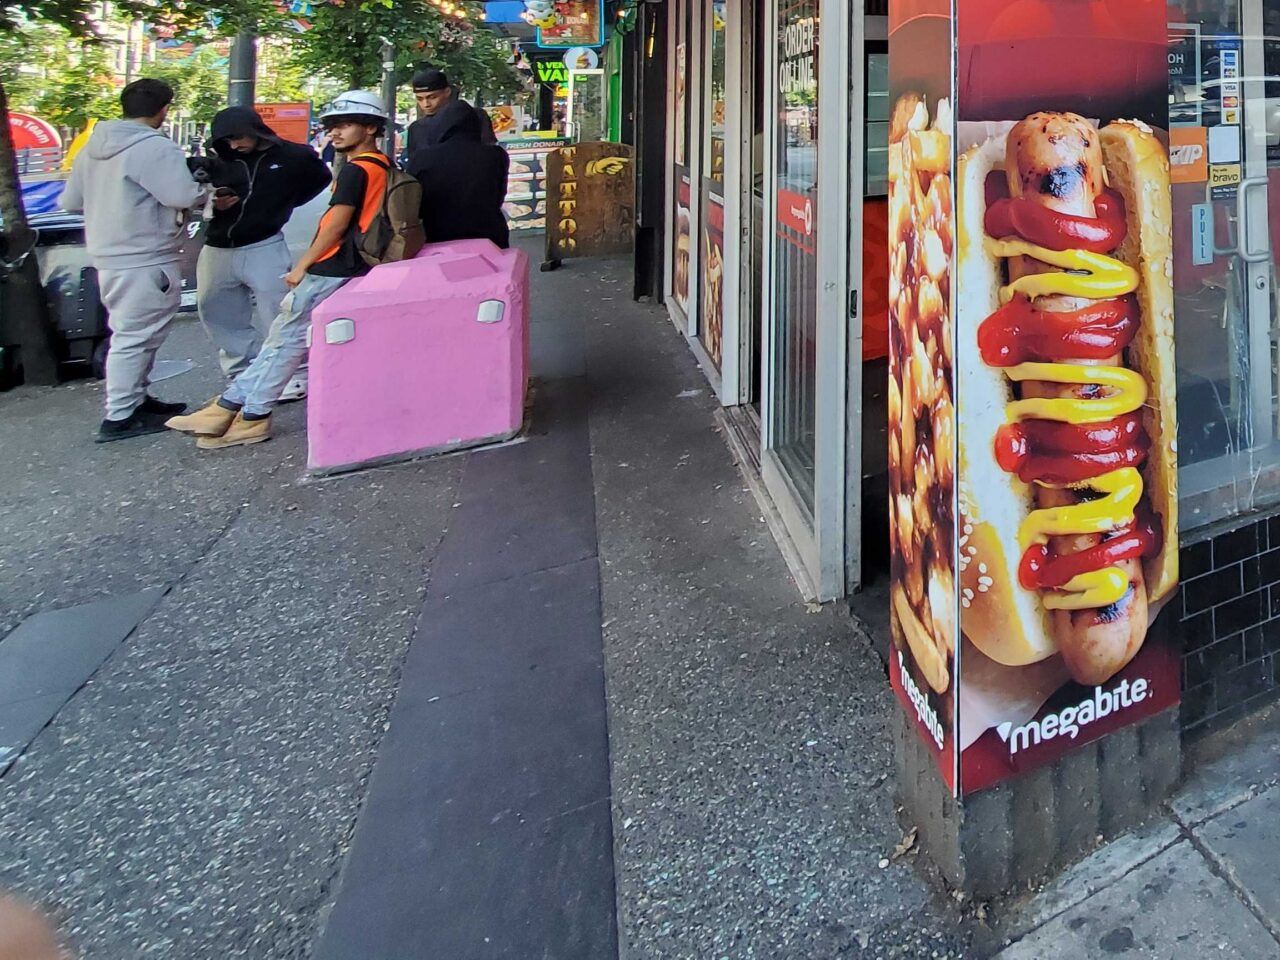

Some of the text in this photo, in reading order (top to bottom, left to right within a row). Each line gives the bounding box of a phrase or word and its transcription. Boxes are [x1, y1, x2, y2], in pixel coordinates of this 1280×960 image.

[785, 17, 814, 58] ORDER
[24, 121, 50, 144] Team
[506, 142, 531, 150] FRESH
[1213, 174, 1238, 183] bravo
[902, 665, 944, 750] megabite
